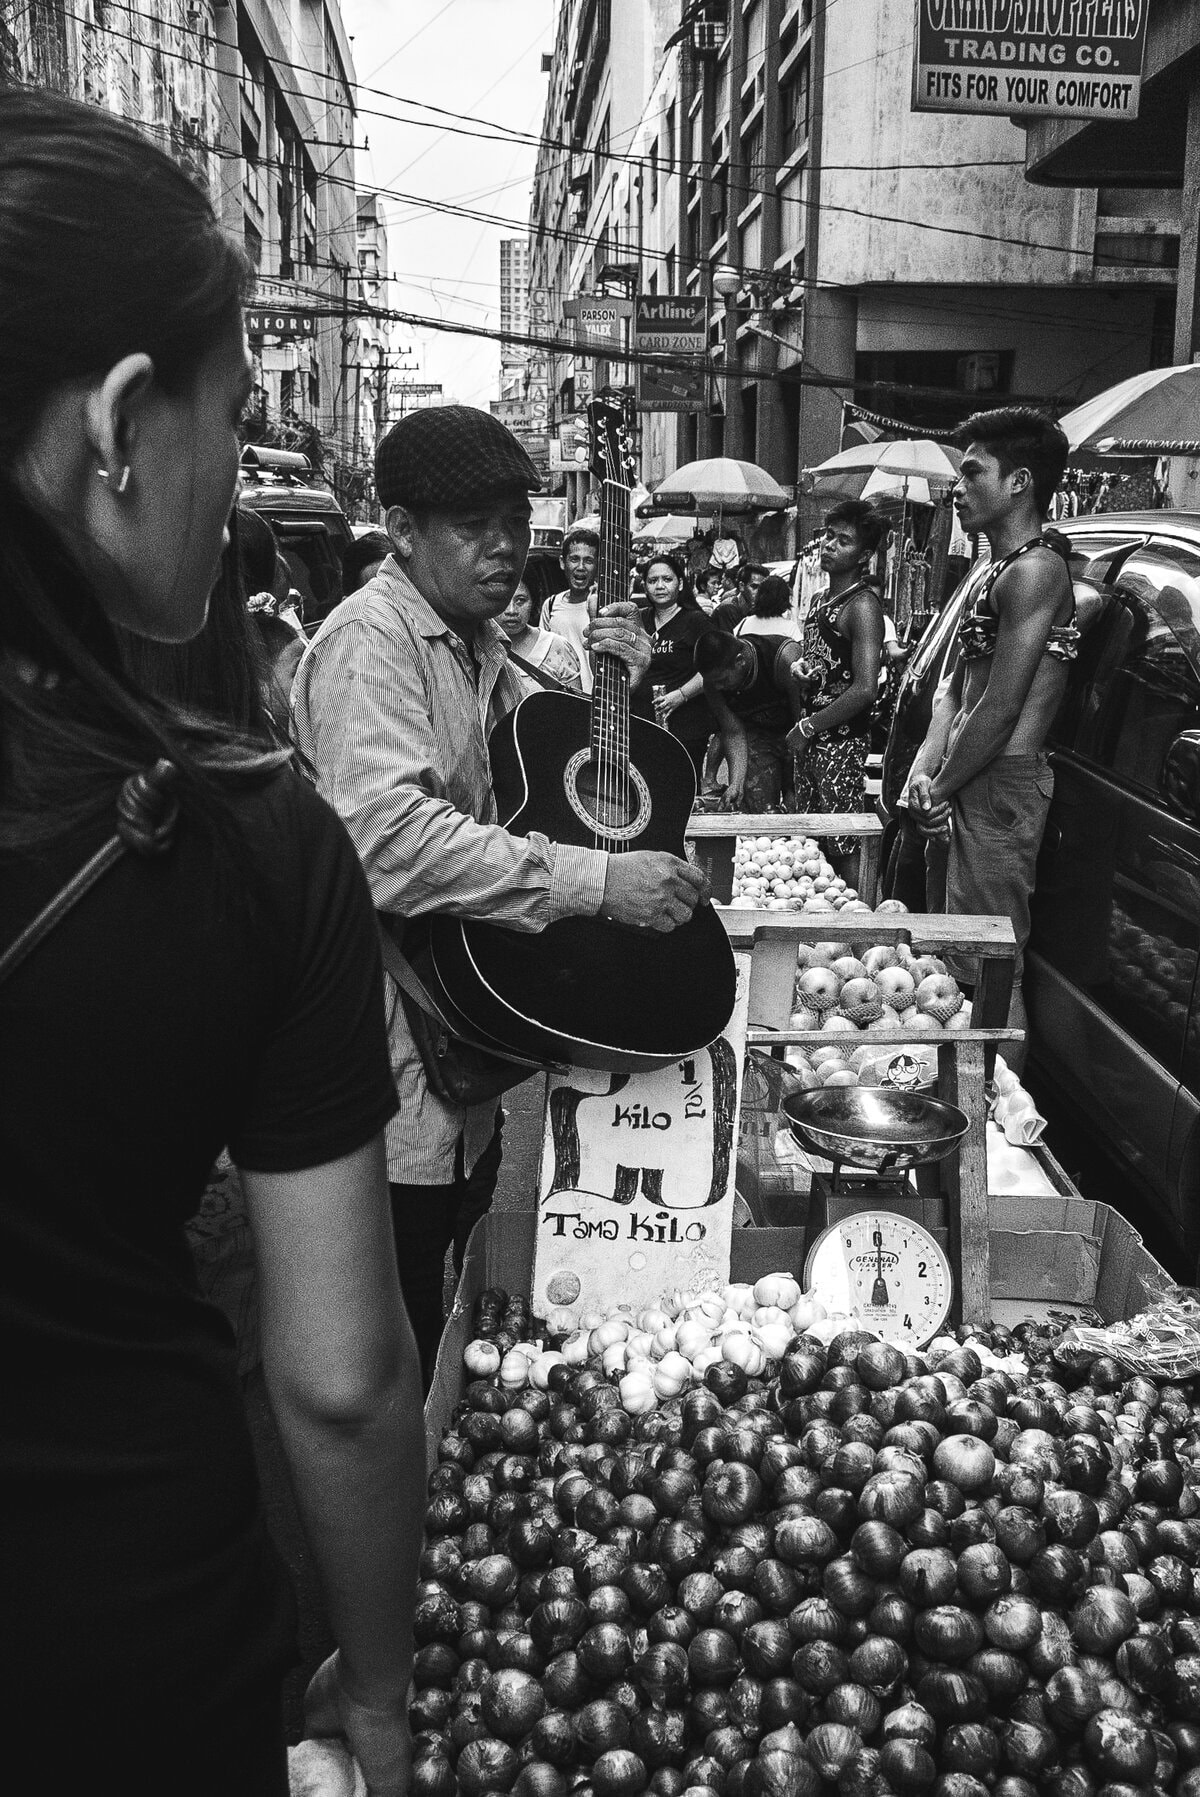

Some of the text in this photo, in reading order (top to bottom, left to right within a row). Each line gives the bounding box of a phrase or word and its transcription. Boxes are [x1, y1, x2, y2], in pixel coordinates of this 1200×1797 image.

[944, 38, 1120, 67] TRADING CO.
[926, 71, 1132, 109] FITS FOR YOUR COMFORT
[581, 309, 616, 321] PARSON
[638, 301, 696, 319] Artline
[640, 337, 702, 349] CARD ZONE
[851, 408, 880, 422] SOUTH
[611, 1103, 672, 1130] Kilo
[903, 1239, 908, 1248] 1
[918, 1262, 927, 1278] 2
[924, 1296, 930, 1305] 3
[903, 1314, 912, 1330] 4
